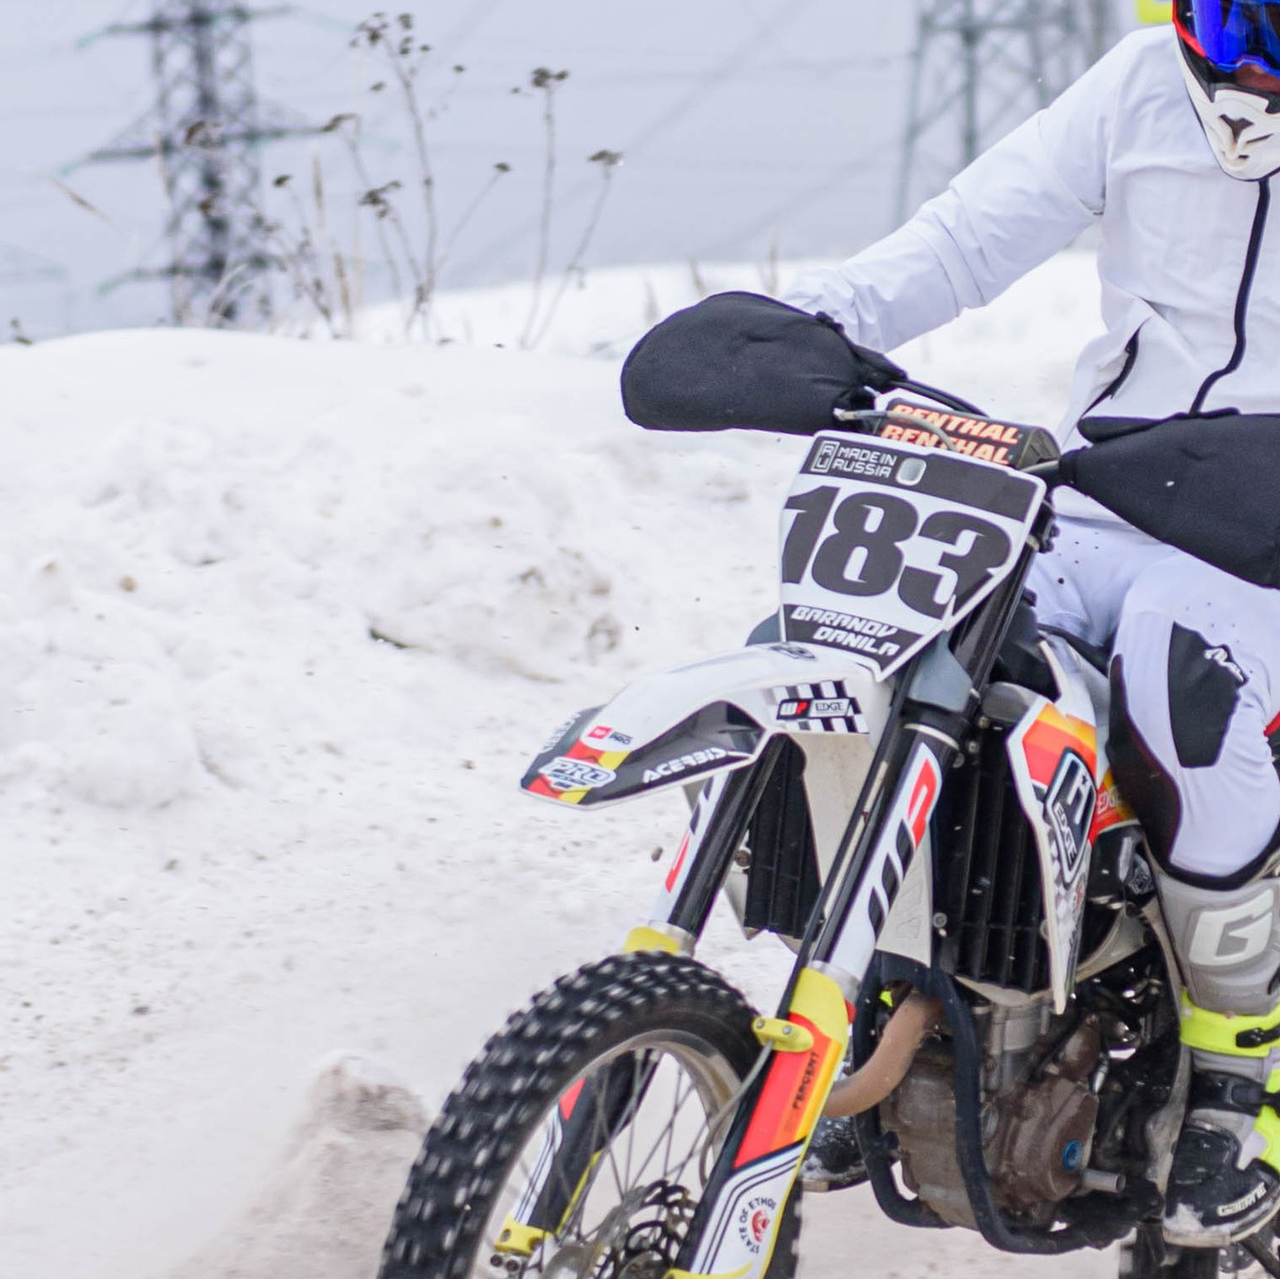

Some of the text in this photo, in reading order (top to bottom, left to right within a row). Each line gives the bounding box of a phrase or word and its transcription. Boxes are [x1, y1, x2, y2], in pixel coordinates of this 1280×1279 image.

[890, 404, 1019, 445] RENTHAL
[838, 446, 898, 466] MADE IN
[881, 424, 1010, 465] RENHAL
[832, 459, 893, 478] RUSSIA
[782, 485, 1012, 620] 183
[791, 606, 899, 638] BARANOV
[813, 627, 900, 655] DANILA
[815, 702, 844, 711] EDGE
[543, 759, 614, 784] PRO
[642, 747, 728, 784] ACERBIS
[1053, 802, 1078, 866] EDGE
